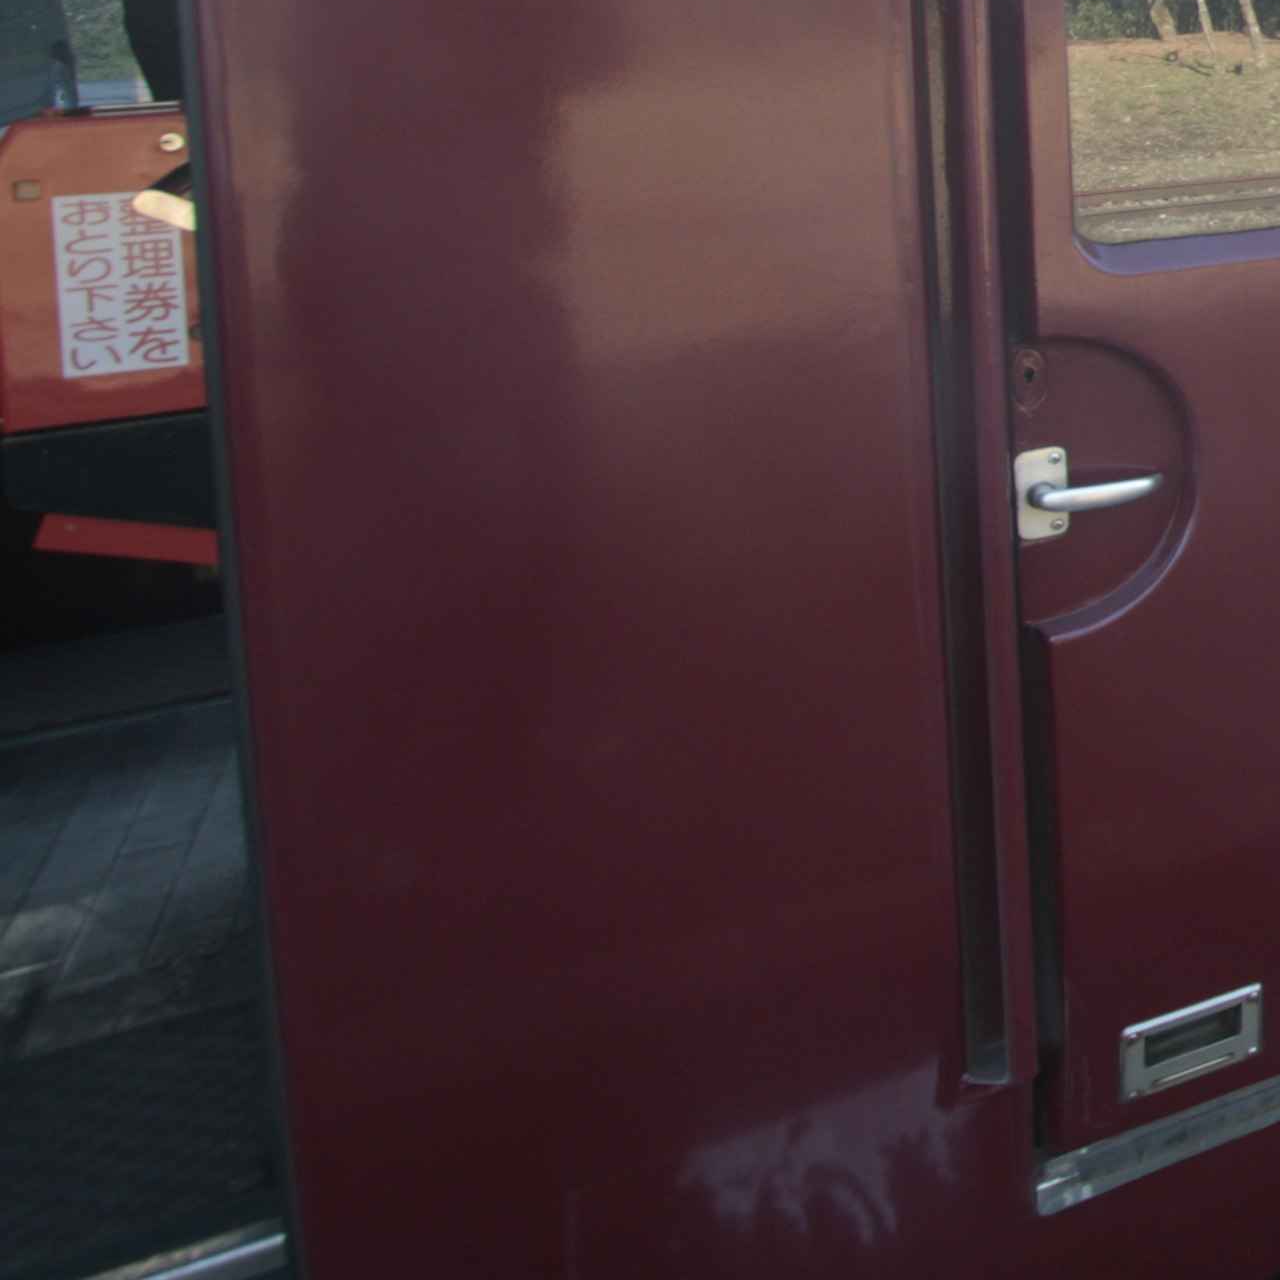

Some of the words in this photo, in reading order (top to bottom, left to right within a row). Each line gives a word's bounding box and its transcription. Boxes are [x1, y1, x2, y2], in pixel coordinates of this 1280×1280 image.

[60, 198, 123, 372] おとり下さい
